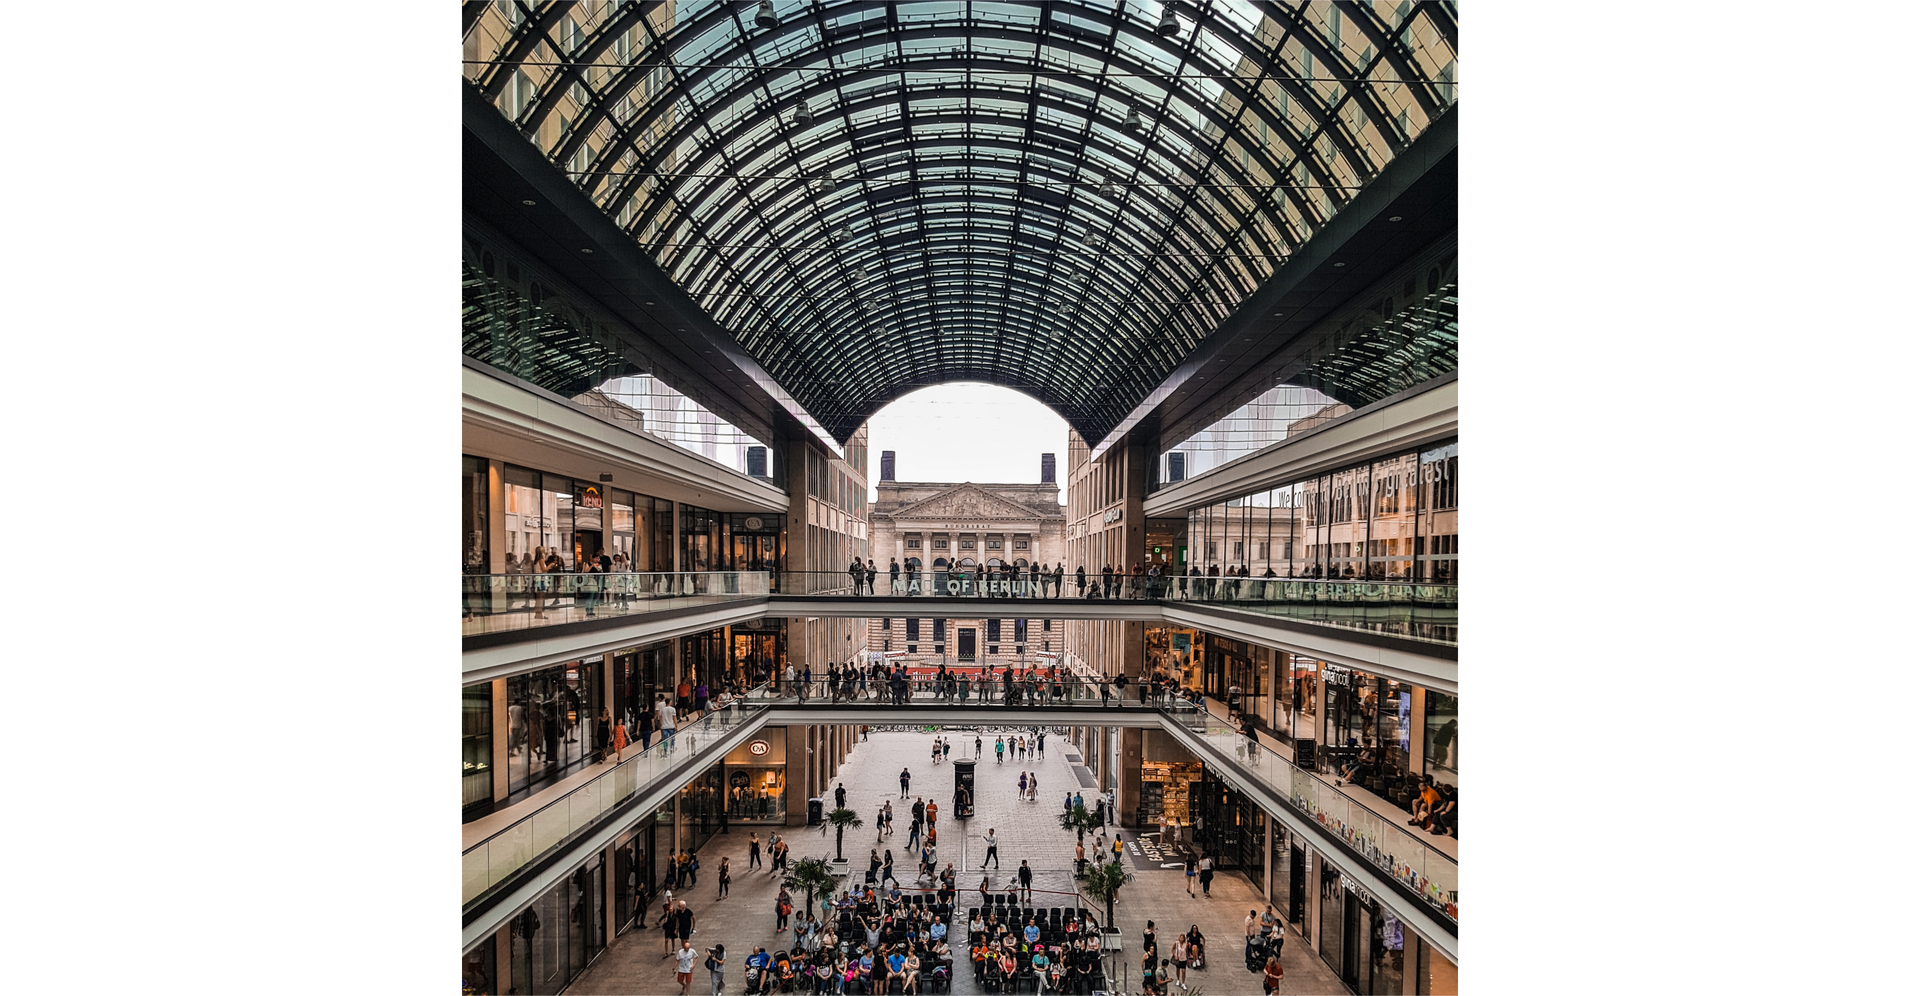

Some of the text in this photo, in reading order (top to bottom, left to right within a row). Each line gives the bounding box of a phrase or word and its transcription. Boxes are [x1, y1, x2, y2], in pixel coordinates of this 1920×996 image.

[892, 579, 1040, 593] MALL OF BERLIN
